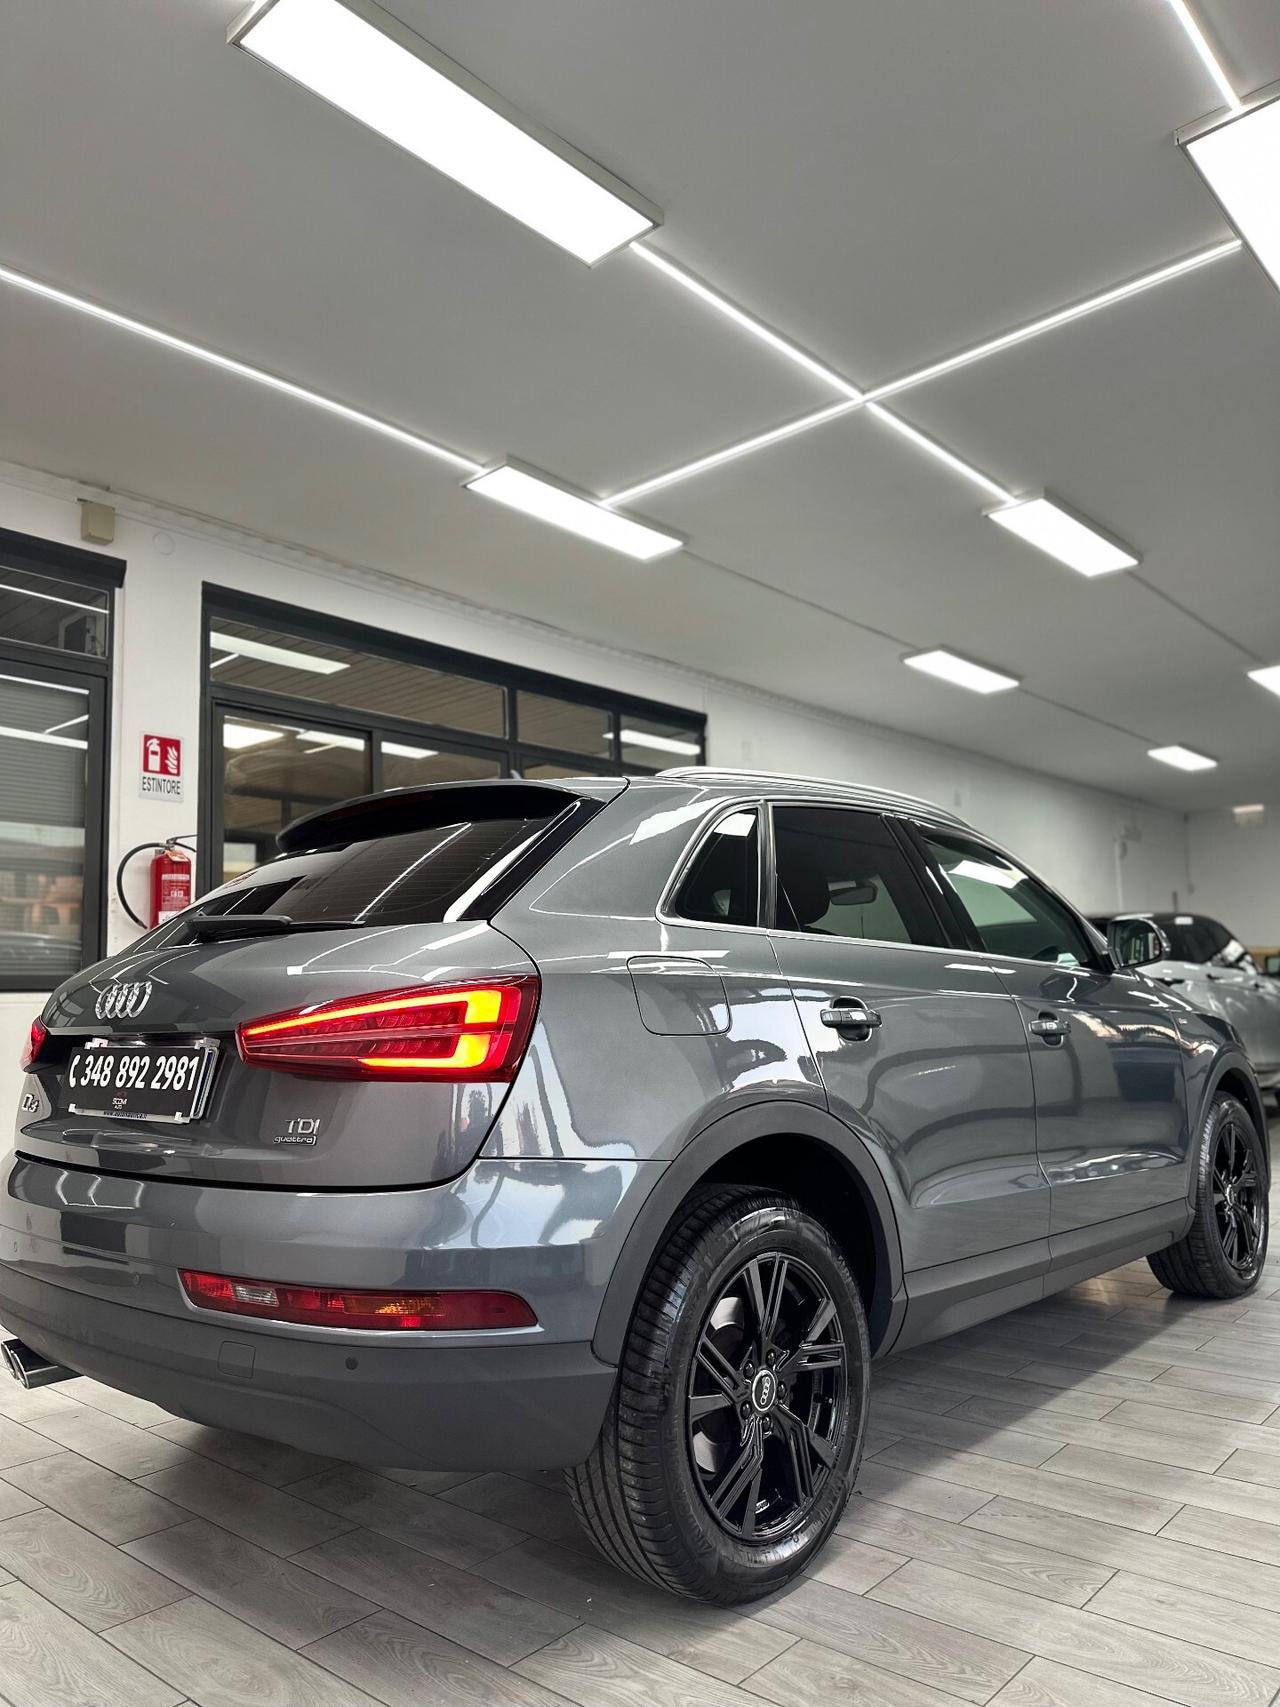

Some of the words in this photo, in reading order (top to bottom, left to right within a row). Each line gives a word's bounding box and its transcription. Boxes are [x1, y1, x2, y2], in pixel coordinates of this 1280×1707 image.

[142, 776, 181, 795] ESTINTORE
[80, 1055, 114, 1087] 348
[115, 1055, 150, 1089] 892
[150, 1055, 200, 1091] 2981
[284, 1118, 321, 1135] TDI
[273, 1136, 313, 1144] quattro
